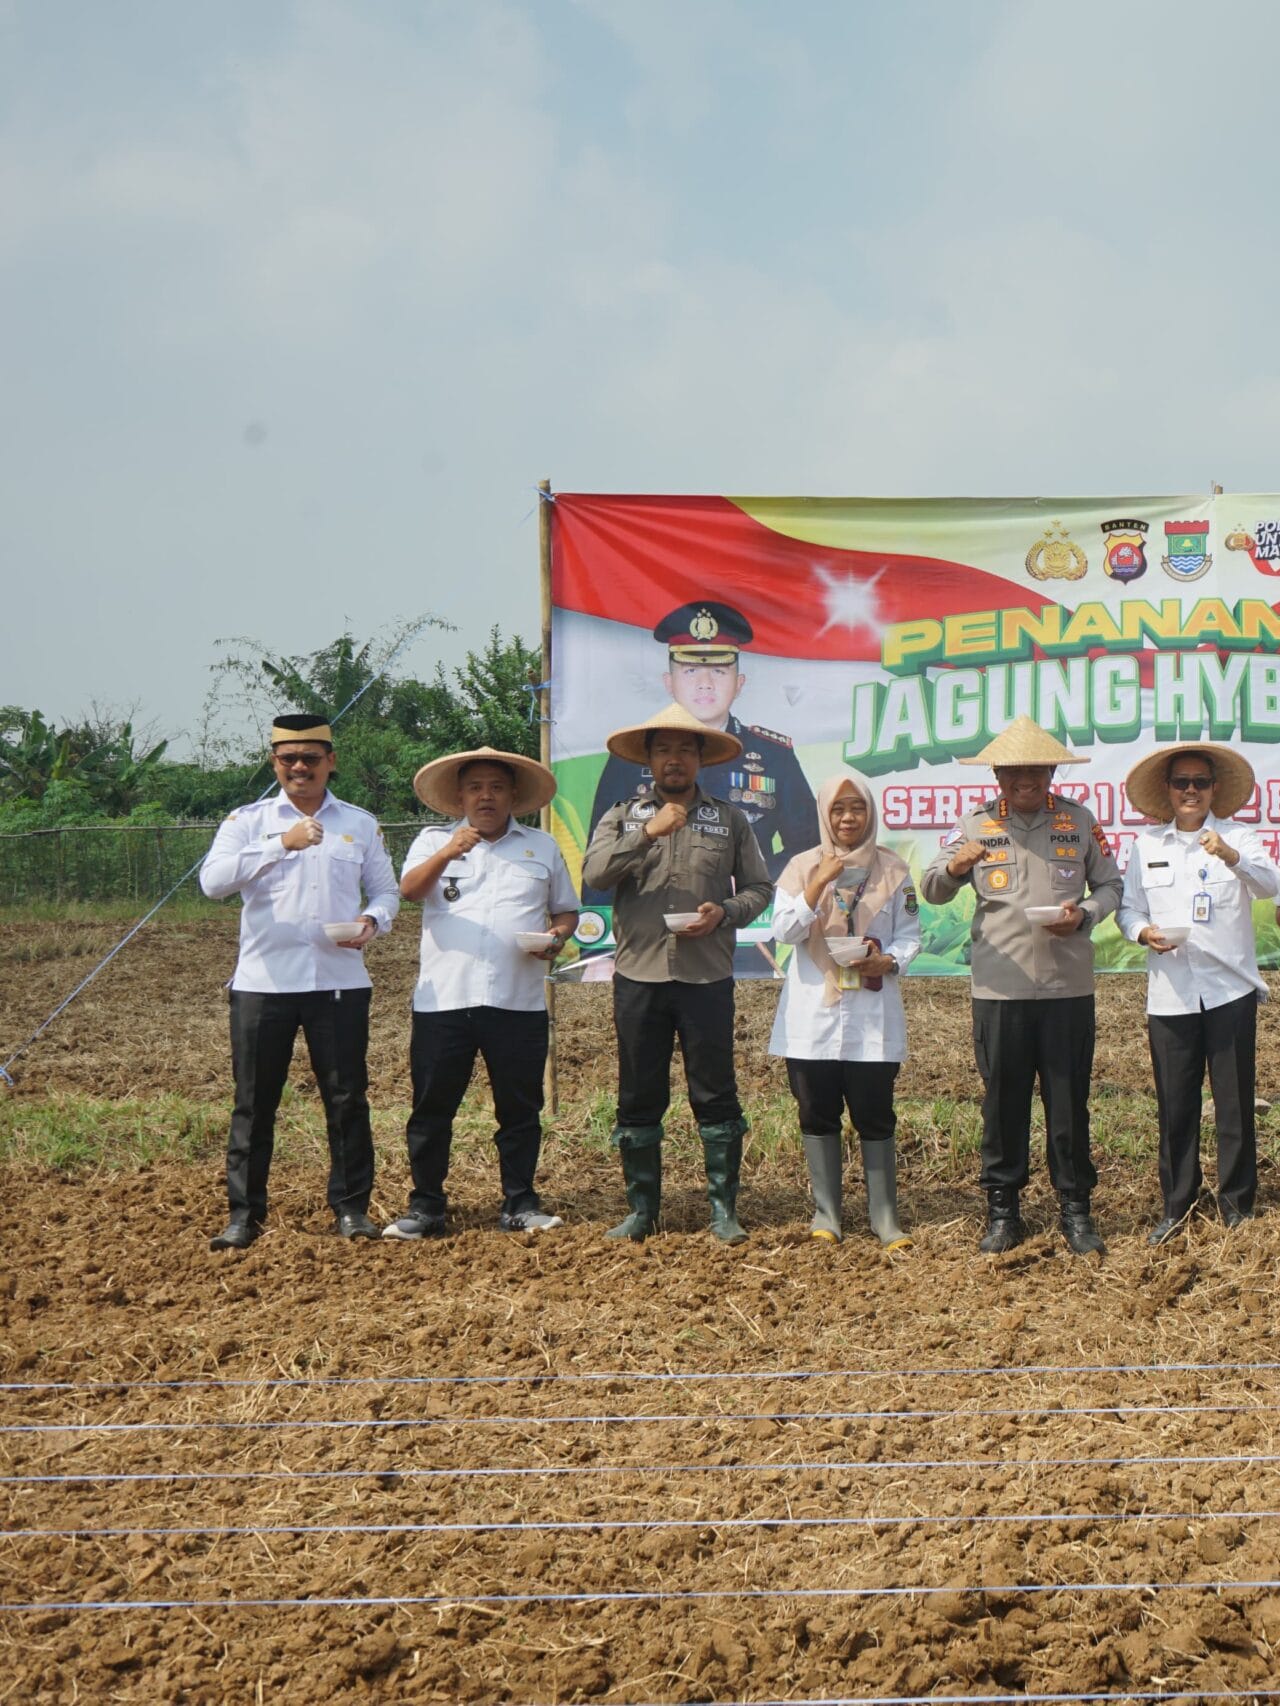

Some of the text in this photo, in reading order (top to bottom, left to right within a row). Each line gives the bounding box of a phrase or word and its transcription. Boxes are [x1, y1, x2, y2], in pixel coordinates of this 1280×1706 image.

[1104, 521, 1146, 531] BANTEN
[843, 654, 1141, 766] JAGUNG
[980, 837, 1011, 847] INDRA
[1050, 834, 1080, 843] POLRI
